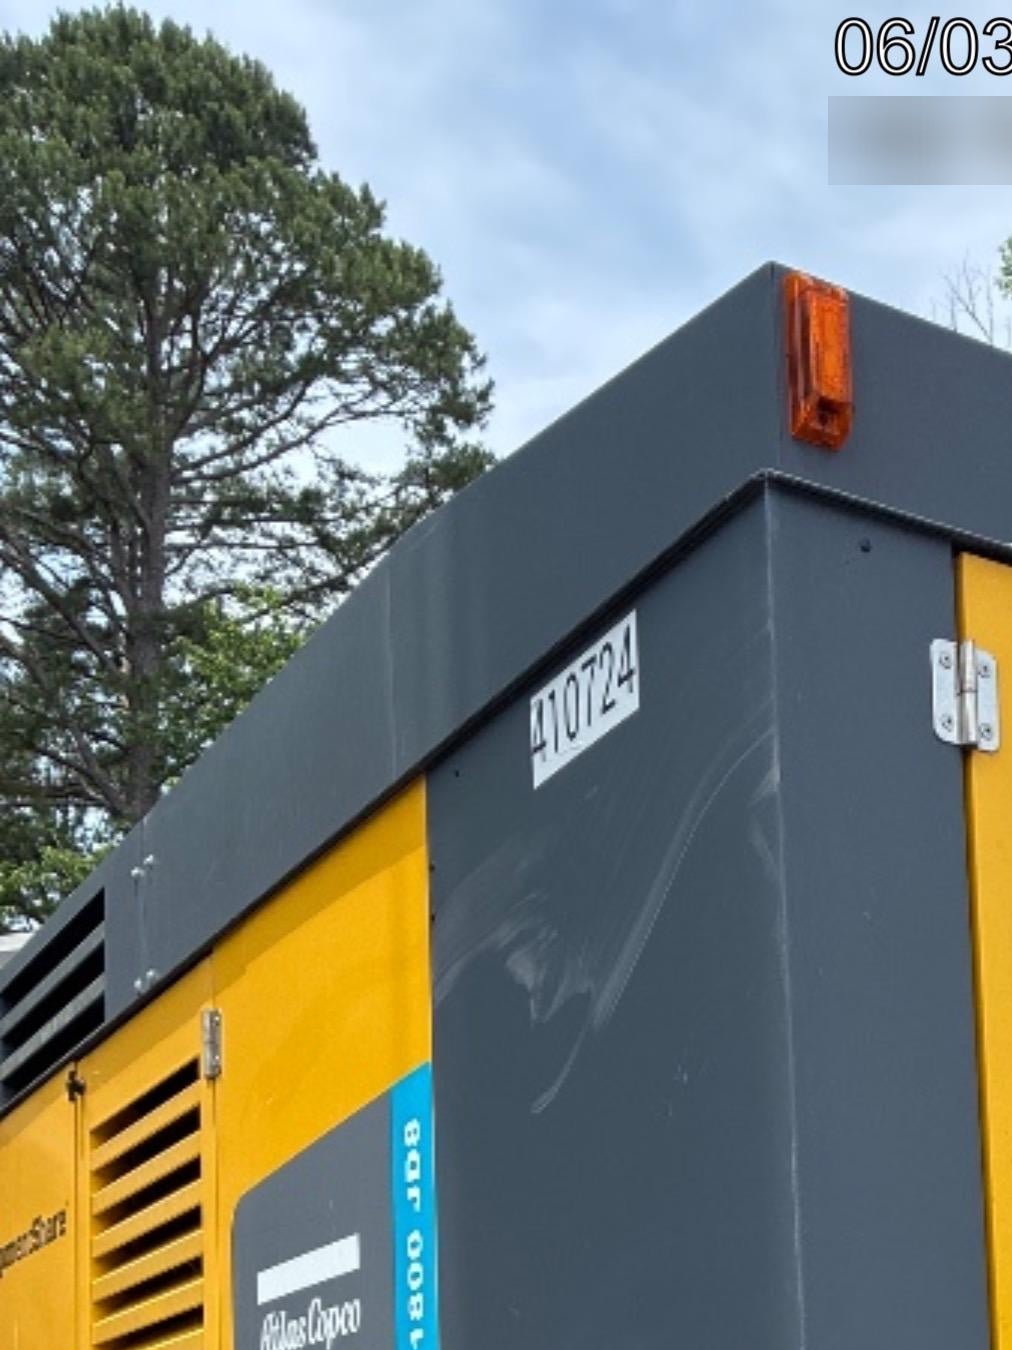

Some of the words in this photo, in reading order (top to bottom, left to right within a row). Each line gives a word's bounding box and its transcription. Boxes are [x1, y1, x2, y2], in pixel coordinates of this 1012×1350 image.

[532, 624, 636, 763] 410724
[308, 1296, 361, 1350] Copco
[407, 1229, 425, 1350] 1800
